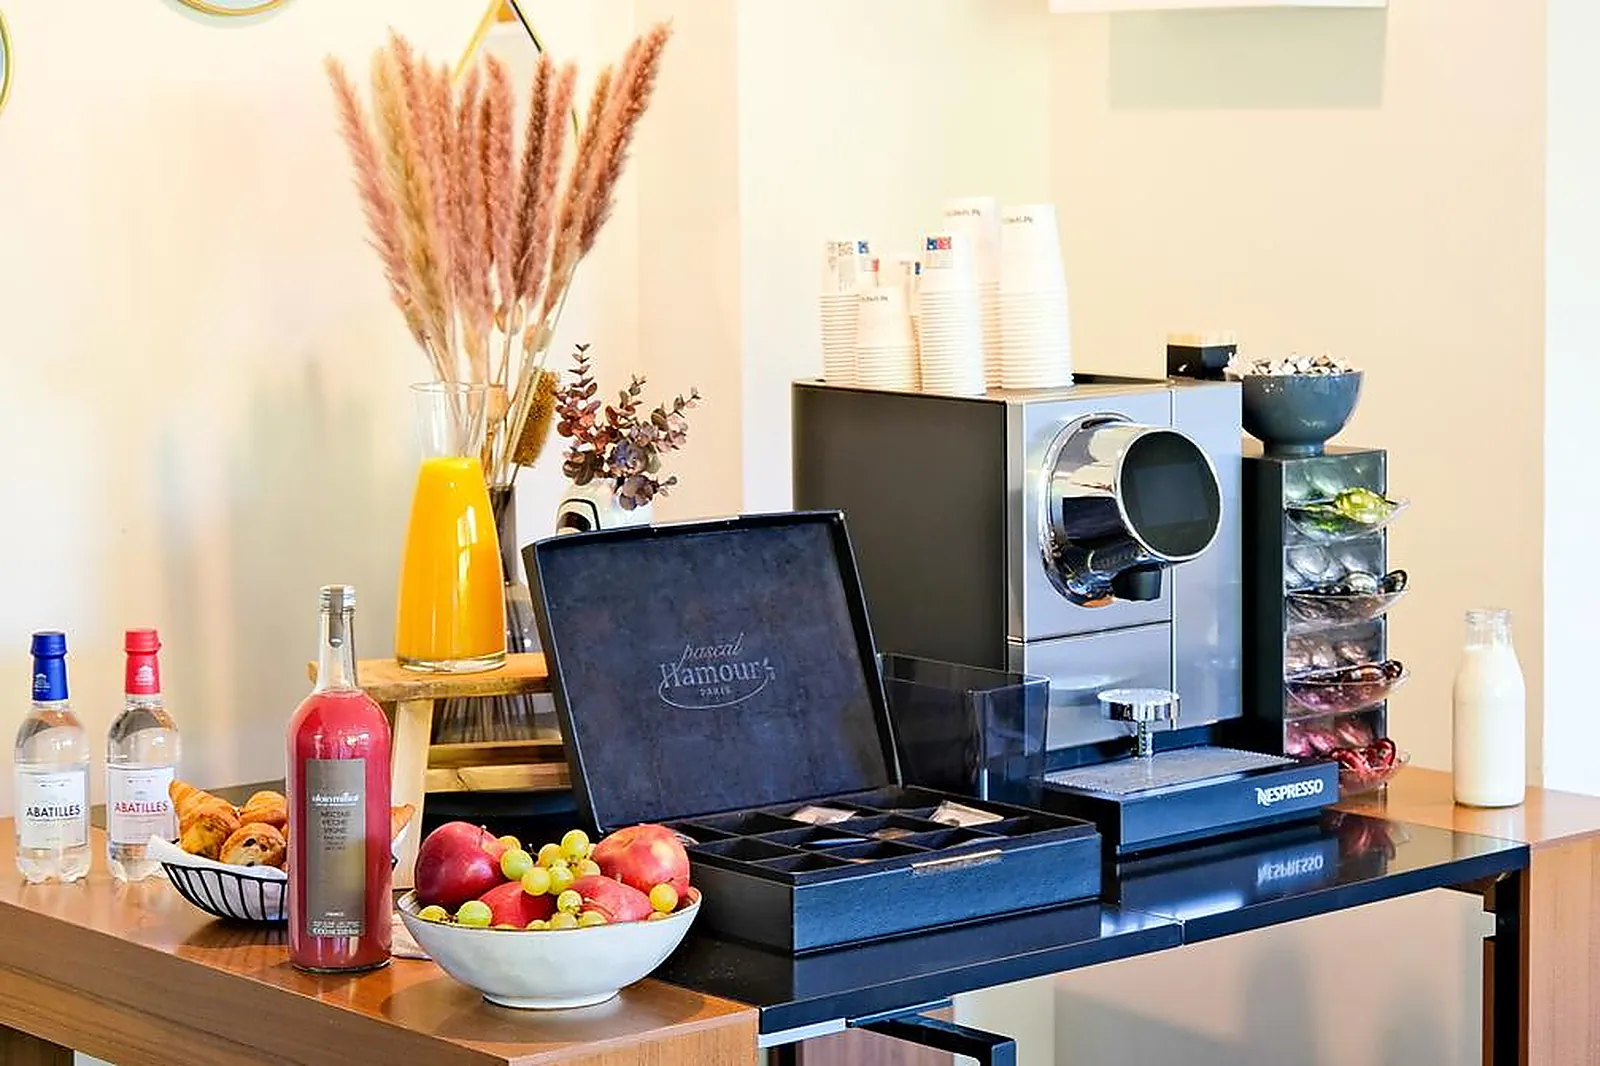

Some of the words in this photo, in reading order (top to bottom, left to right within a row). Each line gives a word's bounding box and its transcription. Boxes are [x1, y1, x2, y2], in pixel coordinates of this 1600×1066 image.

[677, 632, 745, 671] pascal
[1255, 779, 1324, 806] NESPRESSO
[26, 804, 81, 818] ABATILLES
[114, 800, 168, 814] ABATILLES
